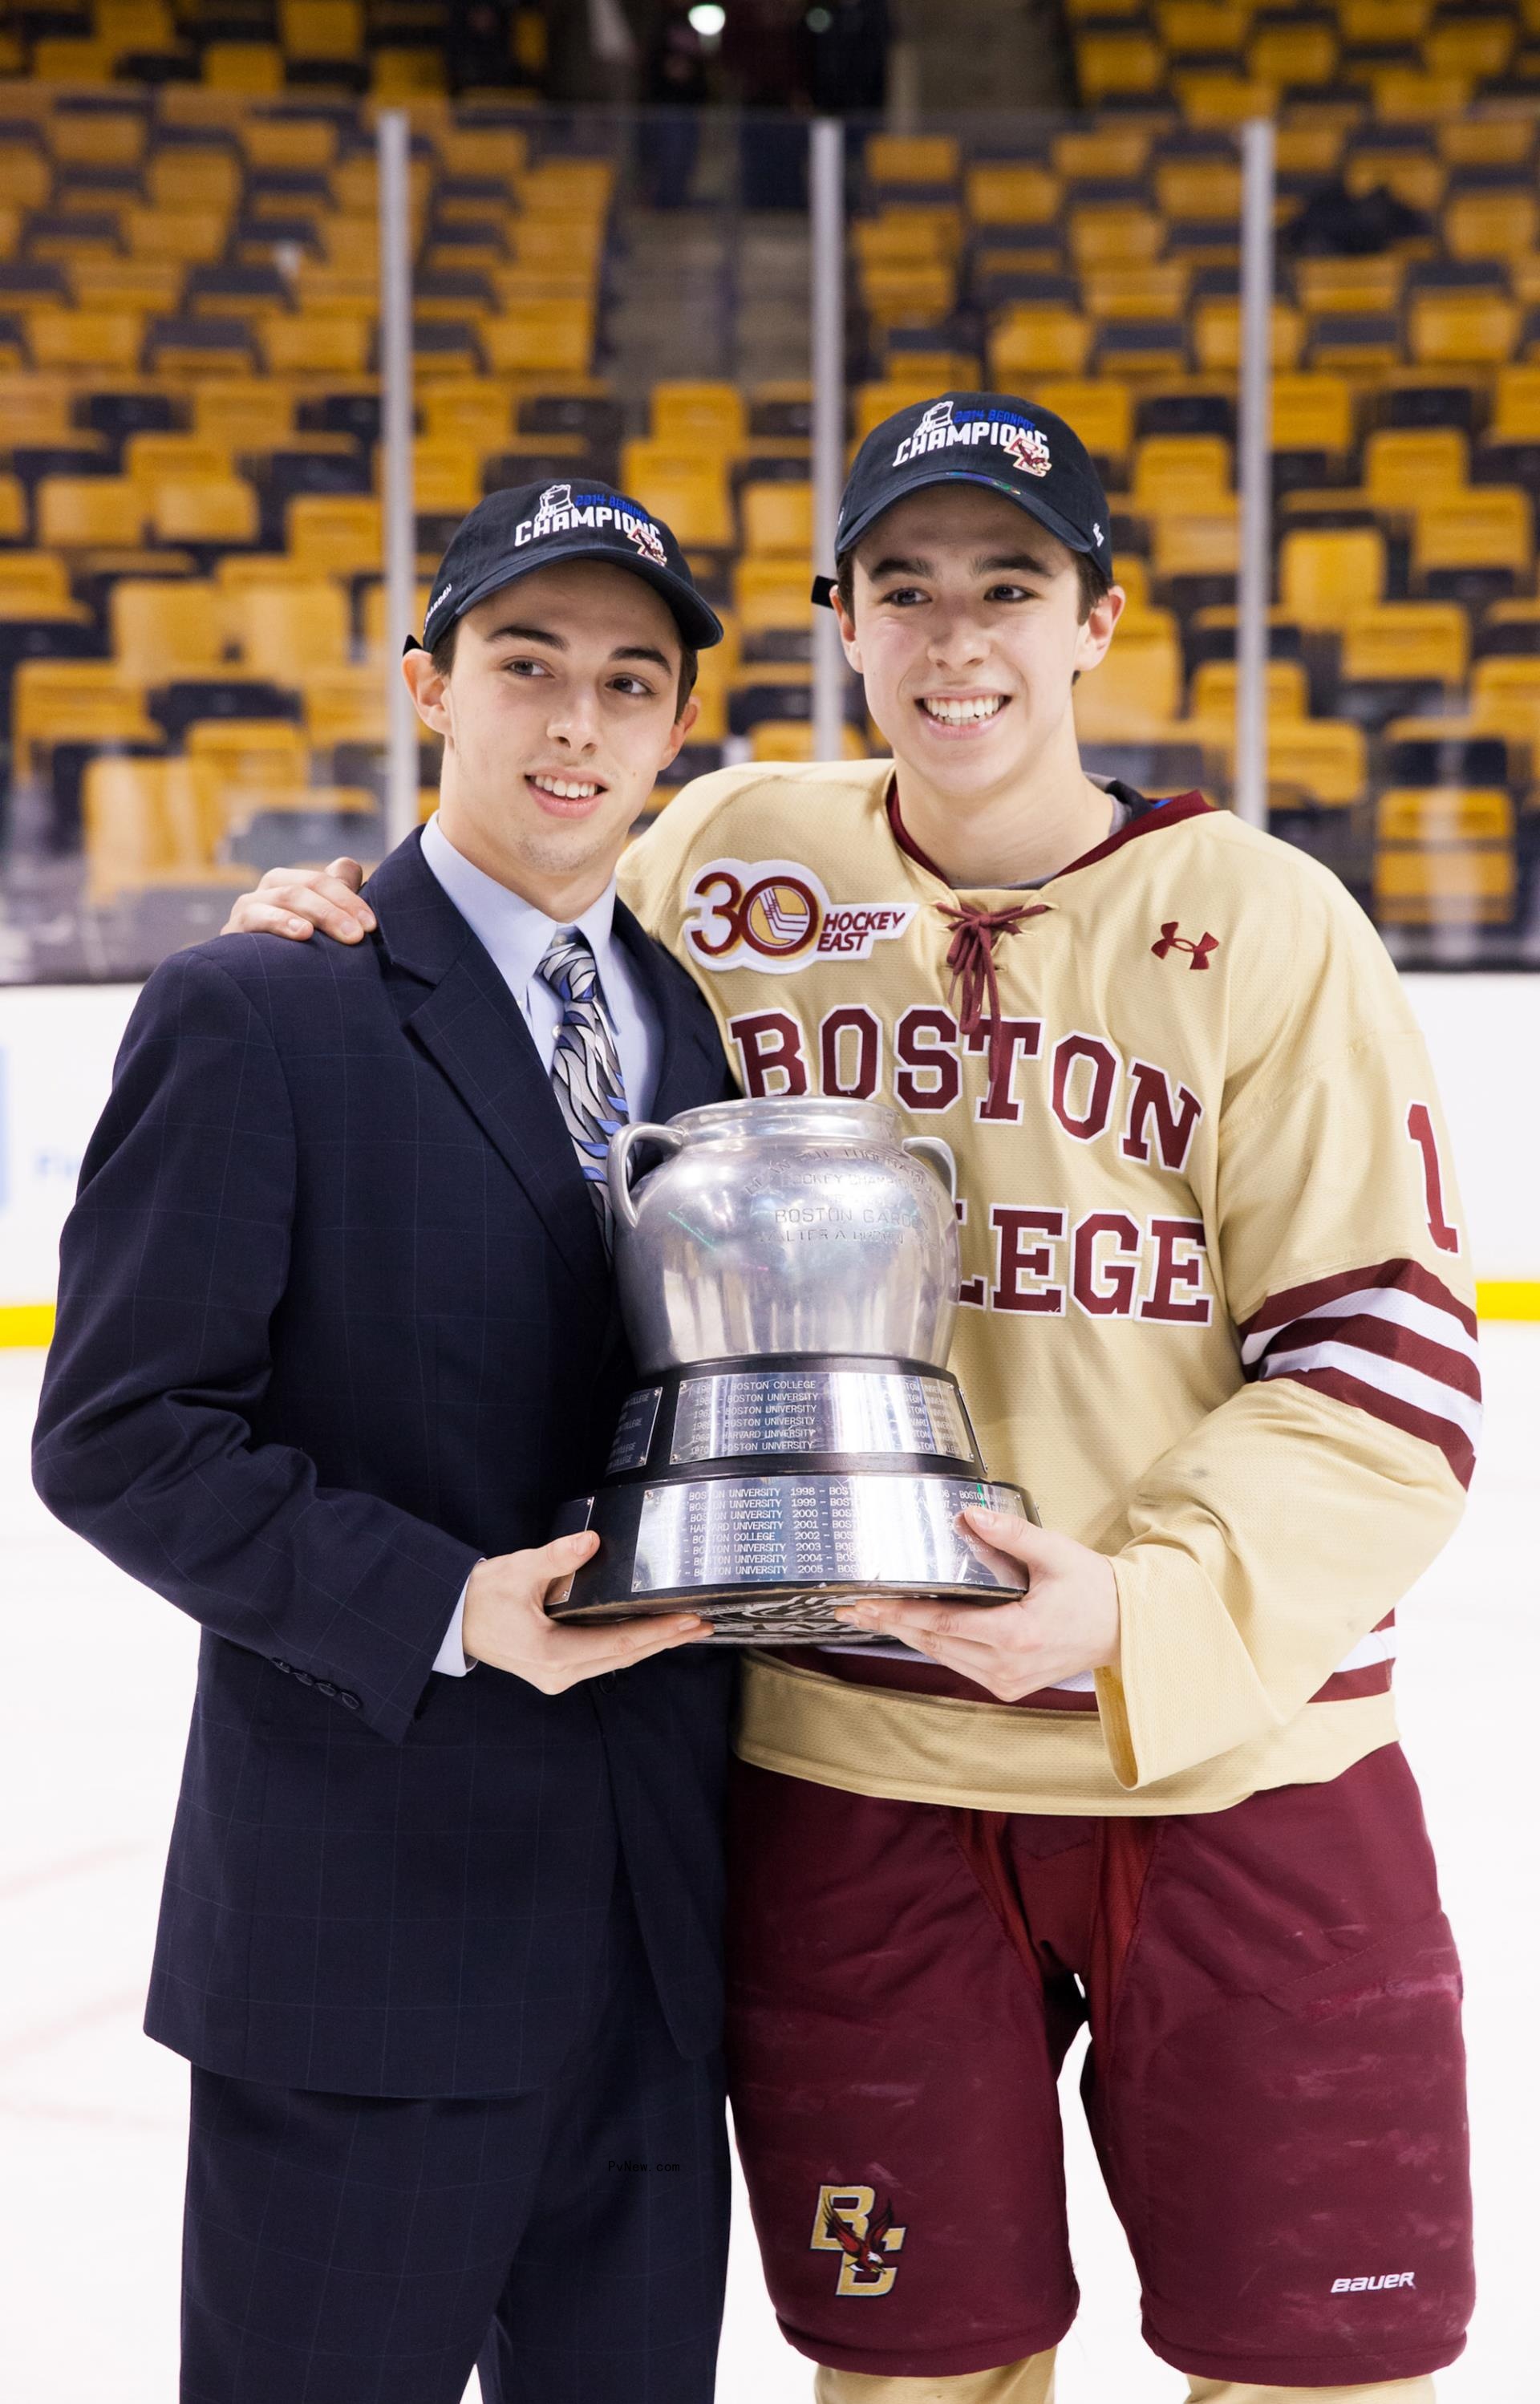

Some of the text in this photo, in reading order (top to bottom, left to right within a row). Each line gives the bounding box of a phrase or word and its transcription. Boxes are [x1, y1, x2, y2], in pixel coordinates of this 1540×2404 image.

[691, 871, 821, 958] 30
[823, 911, 906, 932] HOCKEY
[817, 931, 869, 952] EAST
[727, 1003, 1204, 1174] BOSTON
[775, 1207, 853, 1224] BOSTON
[731, 1381, 769, 1391] BOSTON
[773, 1380, 817, 1389] COLLEGE
[727, 1393, 764, 1404] BOSTON
[767, 1393, 818, 1402] UNIVERSITY
[725, 1406, 762, 1416] BOSTON
[765, 1405, 817, 1413] UNIVERSITY
[724, 1418, 760, 1428] BOSTON
[764, 1417, 816, 1426] UNIVERSITY
[723, 1430, 761, 1440] HARVARD
[764, 1429, 817, 1438] UNIVERSITY
[721, 1442, 758, 1452] BOSTON
[762, 1441, 813, 1450] UNIVERSITY
[689, 1490, 725, 1501] BOSON
[728, 1488, 781, 1498] UNIVERSITY
[790, 1486, 816, 1496] 1998
[689, 1501, 726, 1511] BOSON
[729, 1499, 782, 1509] UNIVERSITY
[791, 1498, 817, 1507] 1999
[690, 1512, 727, 1522] BOSON
[731, 1510, 783, 1520] UNIVERSITY
[792, 1509, 818, 1518] 2000
[733, 1521, 784, 1530] UNIVERSITY
[793, 1520, 819, 1530] 2001
[692, 1534, 730, 1544] BOTON
[733, 1531, 776, 1542] COLLEGE
[794, 1530, 820, 1540] 2002
[692, 1544, 730, 1555] BOTON
[733, 1543, 786, 1553] UNIVERSITY
[796, 1542, 821, 1551] 2003
[735, 1555, 788, 1564] UNIVERSITY
[796, 1553, 823, 1563] 2004
[735, 1565, 788, 1575] UNIVERSITY
[797, 1564, 824, 1574] 2005
[1331, 2271, 1416, 2293] BAUER
